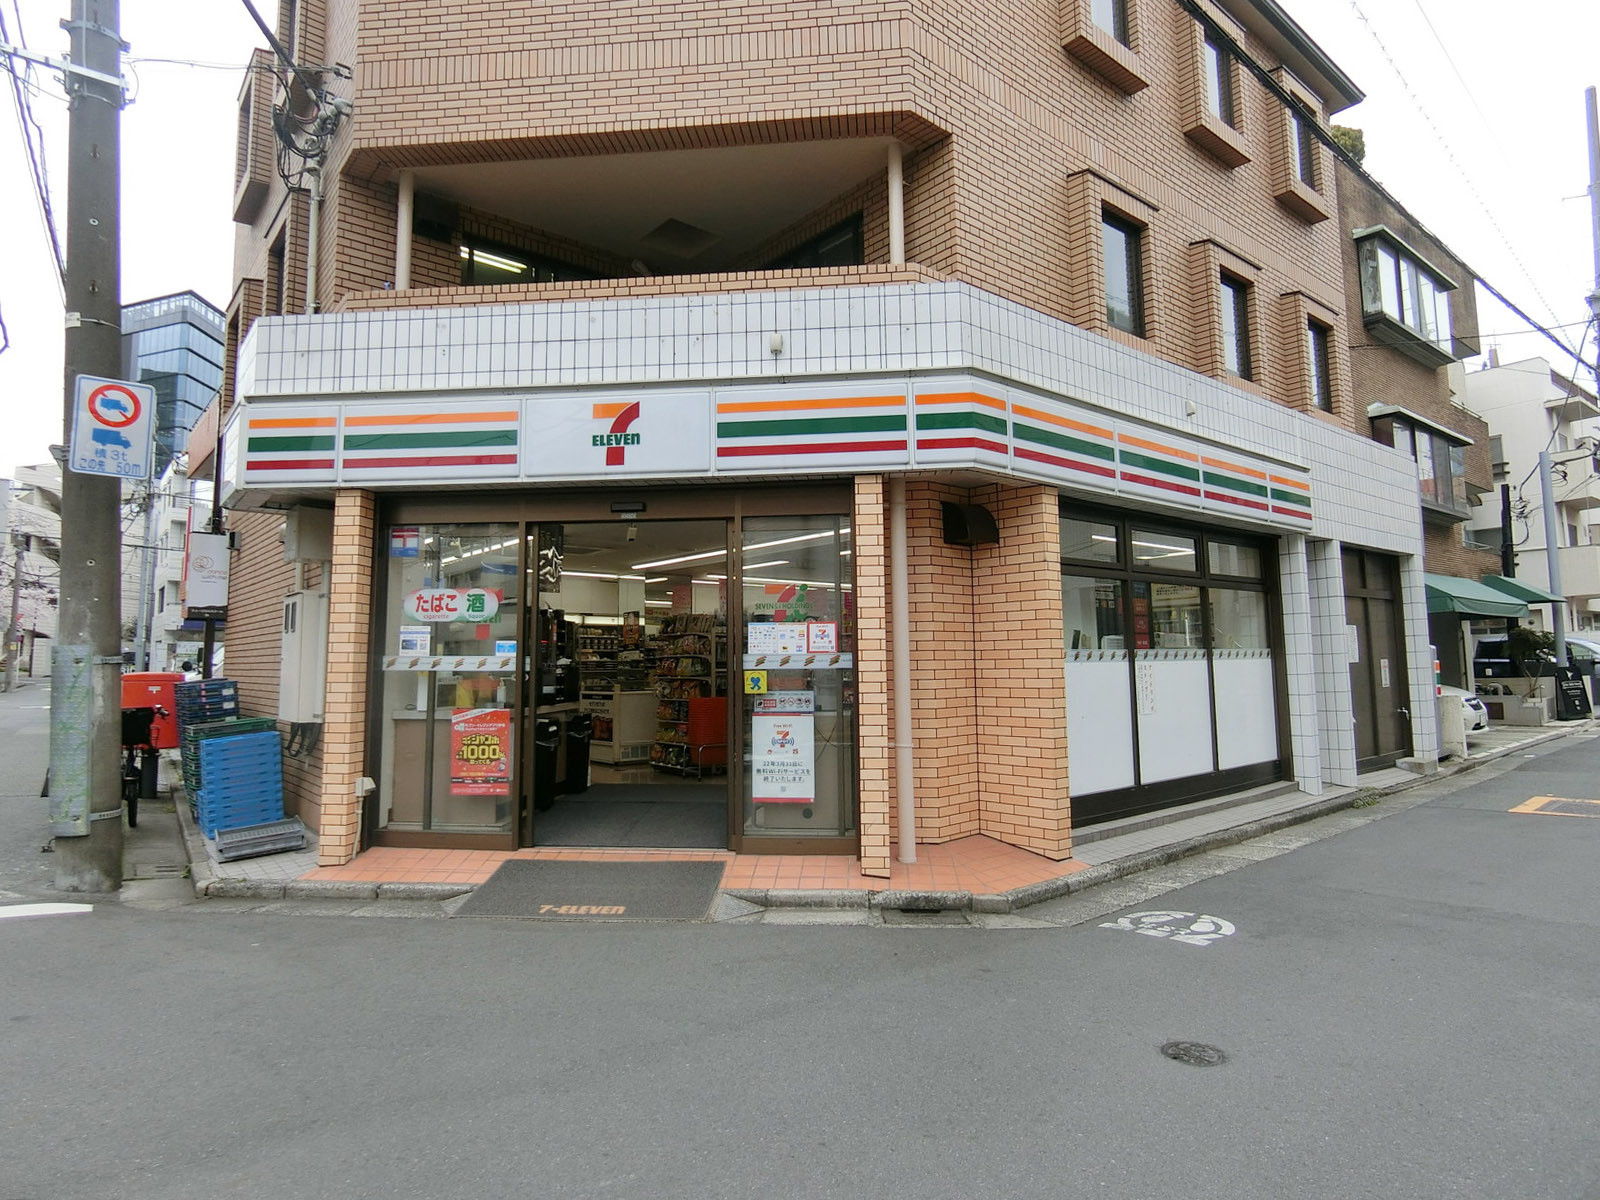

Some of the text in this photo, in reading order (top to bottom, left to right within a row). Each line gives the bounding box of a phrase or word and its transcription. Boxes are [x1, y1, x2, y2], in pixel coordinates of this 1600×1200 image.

[79, 457, 141, 475] この先 50m
[415, 593, 458, 613] たばこ
[466, 593, 485, 613] 酒
